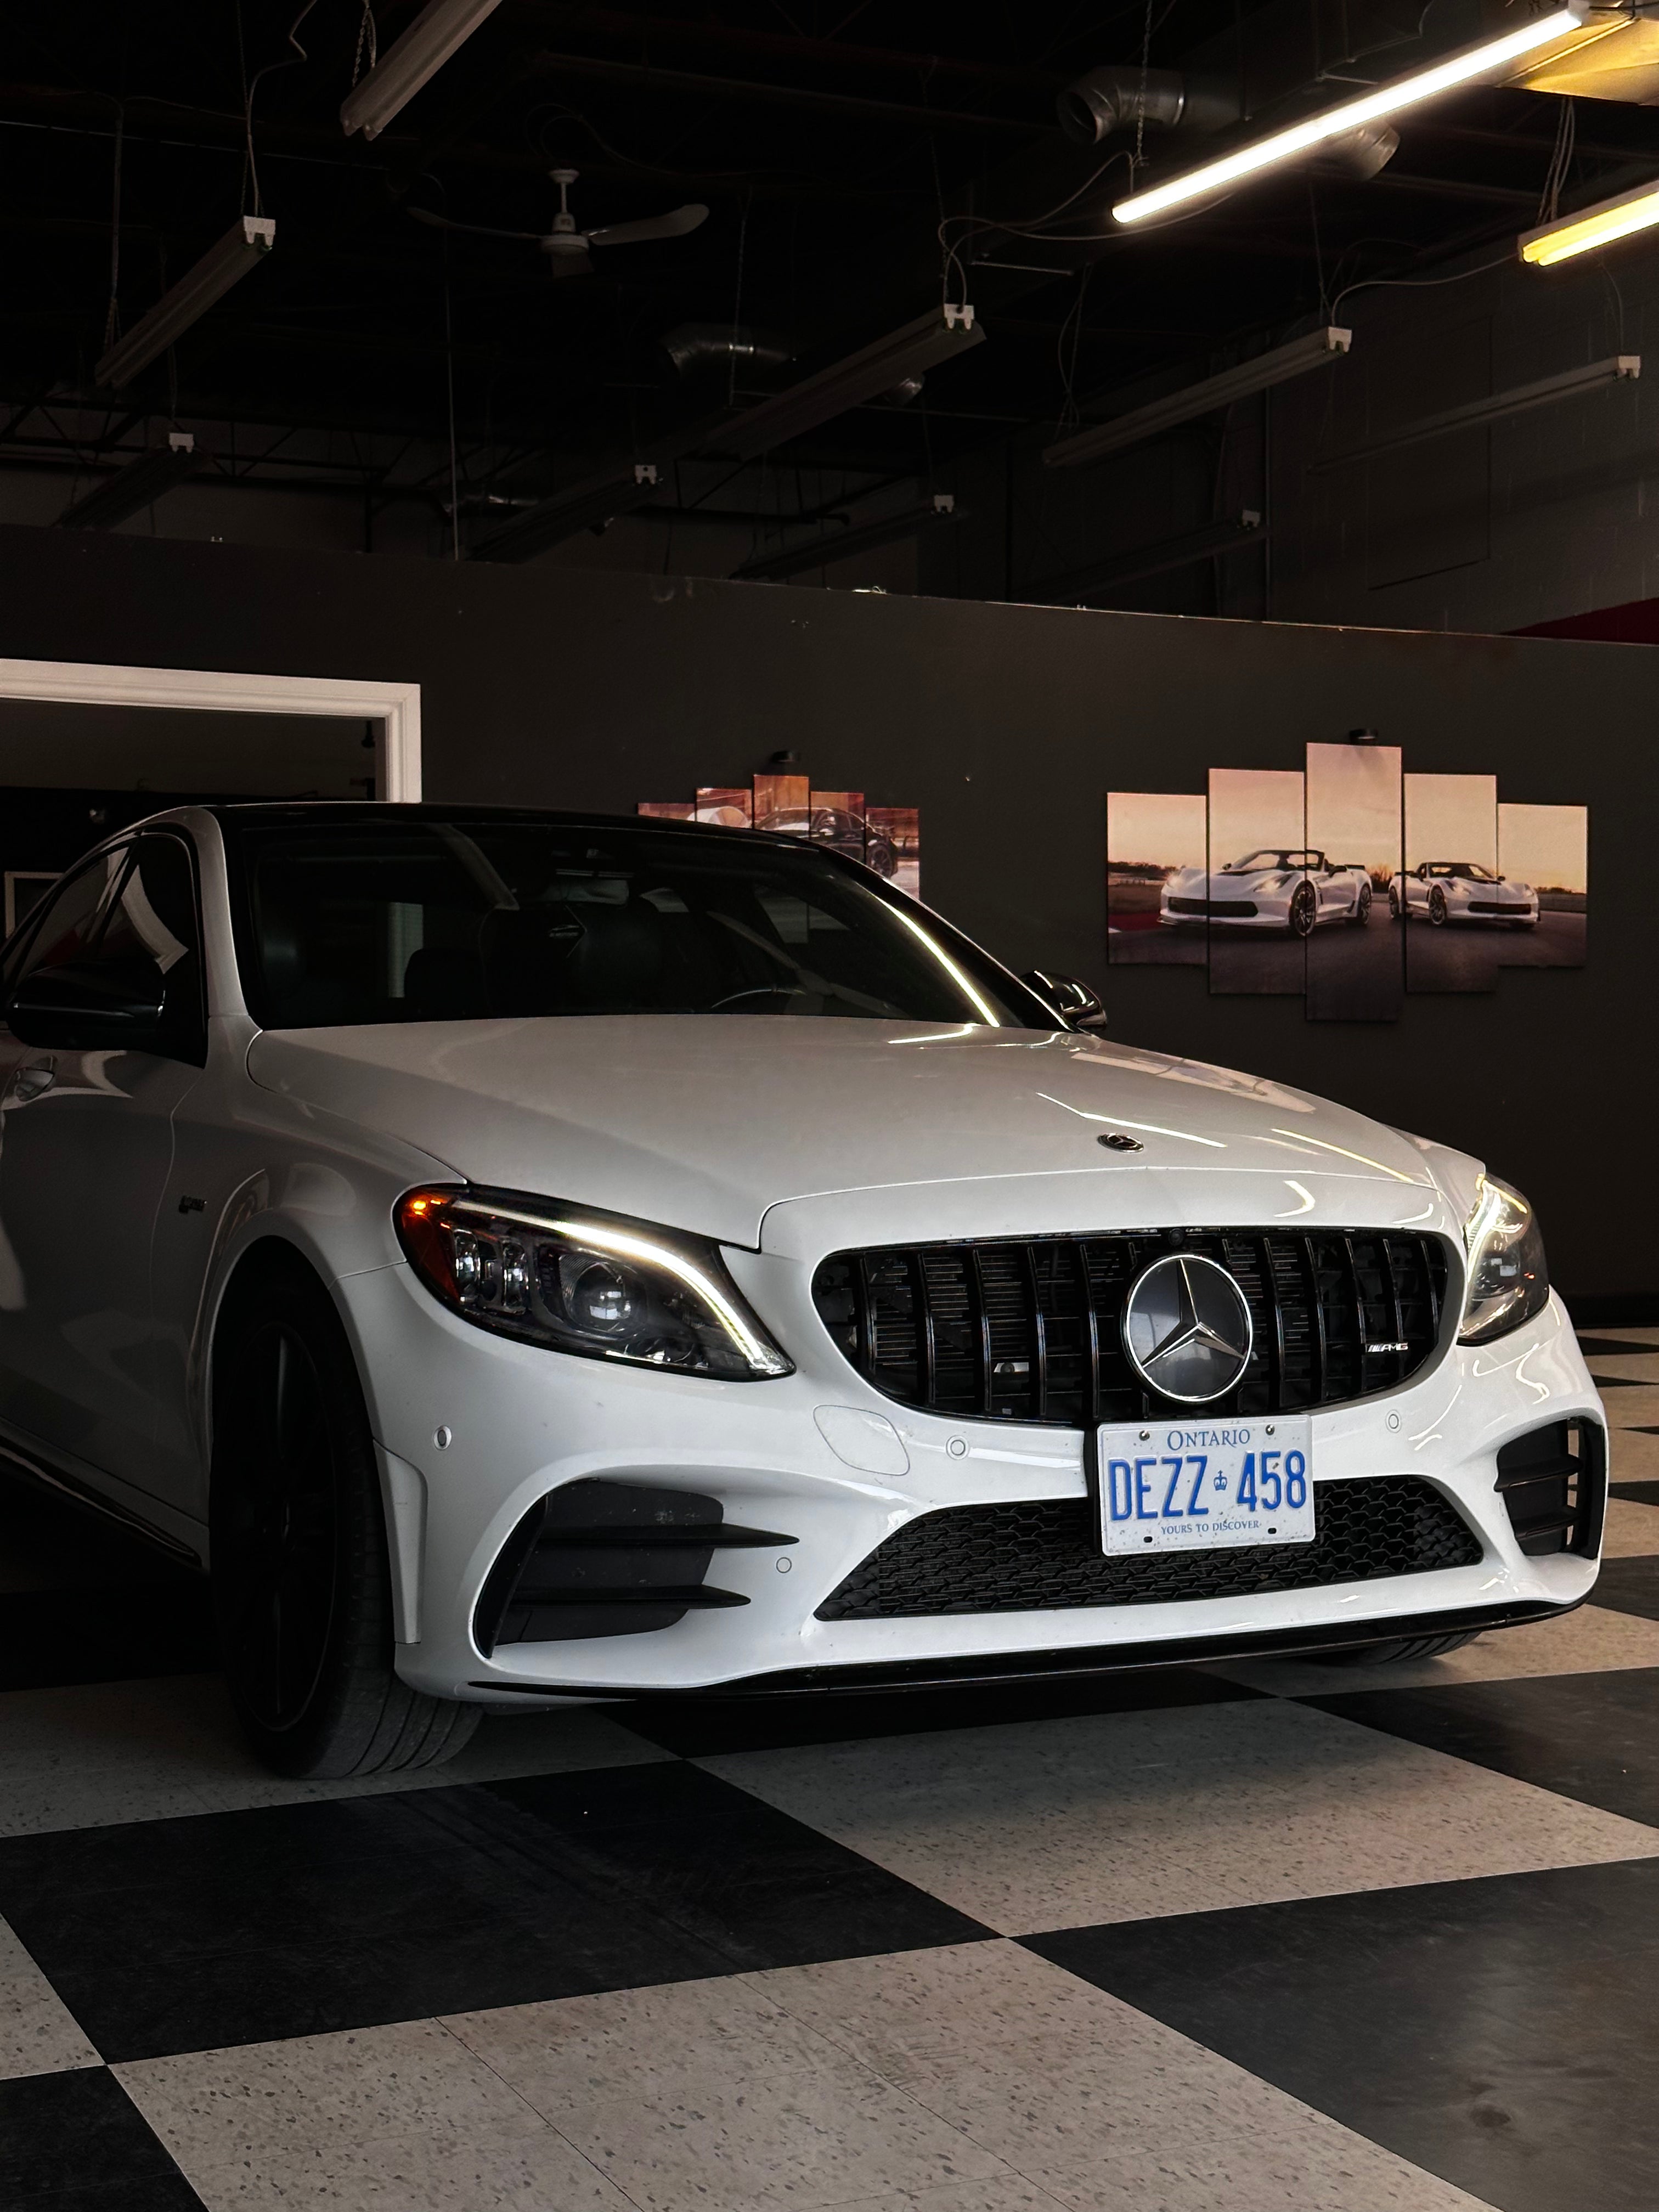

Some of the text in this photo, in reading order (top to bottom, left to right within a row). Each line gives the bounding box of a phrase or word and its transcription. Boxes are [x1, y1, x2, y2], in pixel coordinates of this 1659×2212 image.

[1380, 1342, 1409, 1352] AMG
[1167, 1429, 1251, 1451] ONTARIO
[1108, 1450, 1307, 1521] DEZZ 458
[1161, 1520, 1260, 1535] YOURS TO DISCOVER
